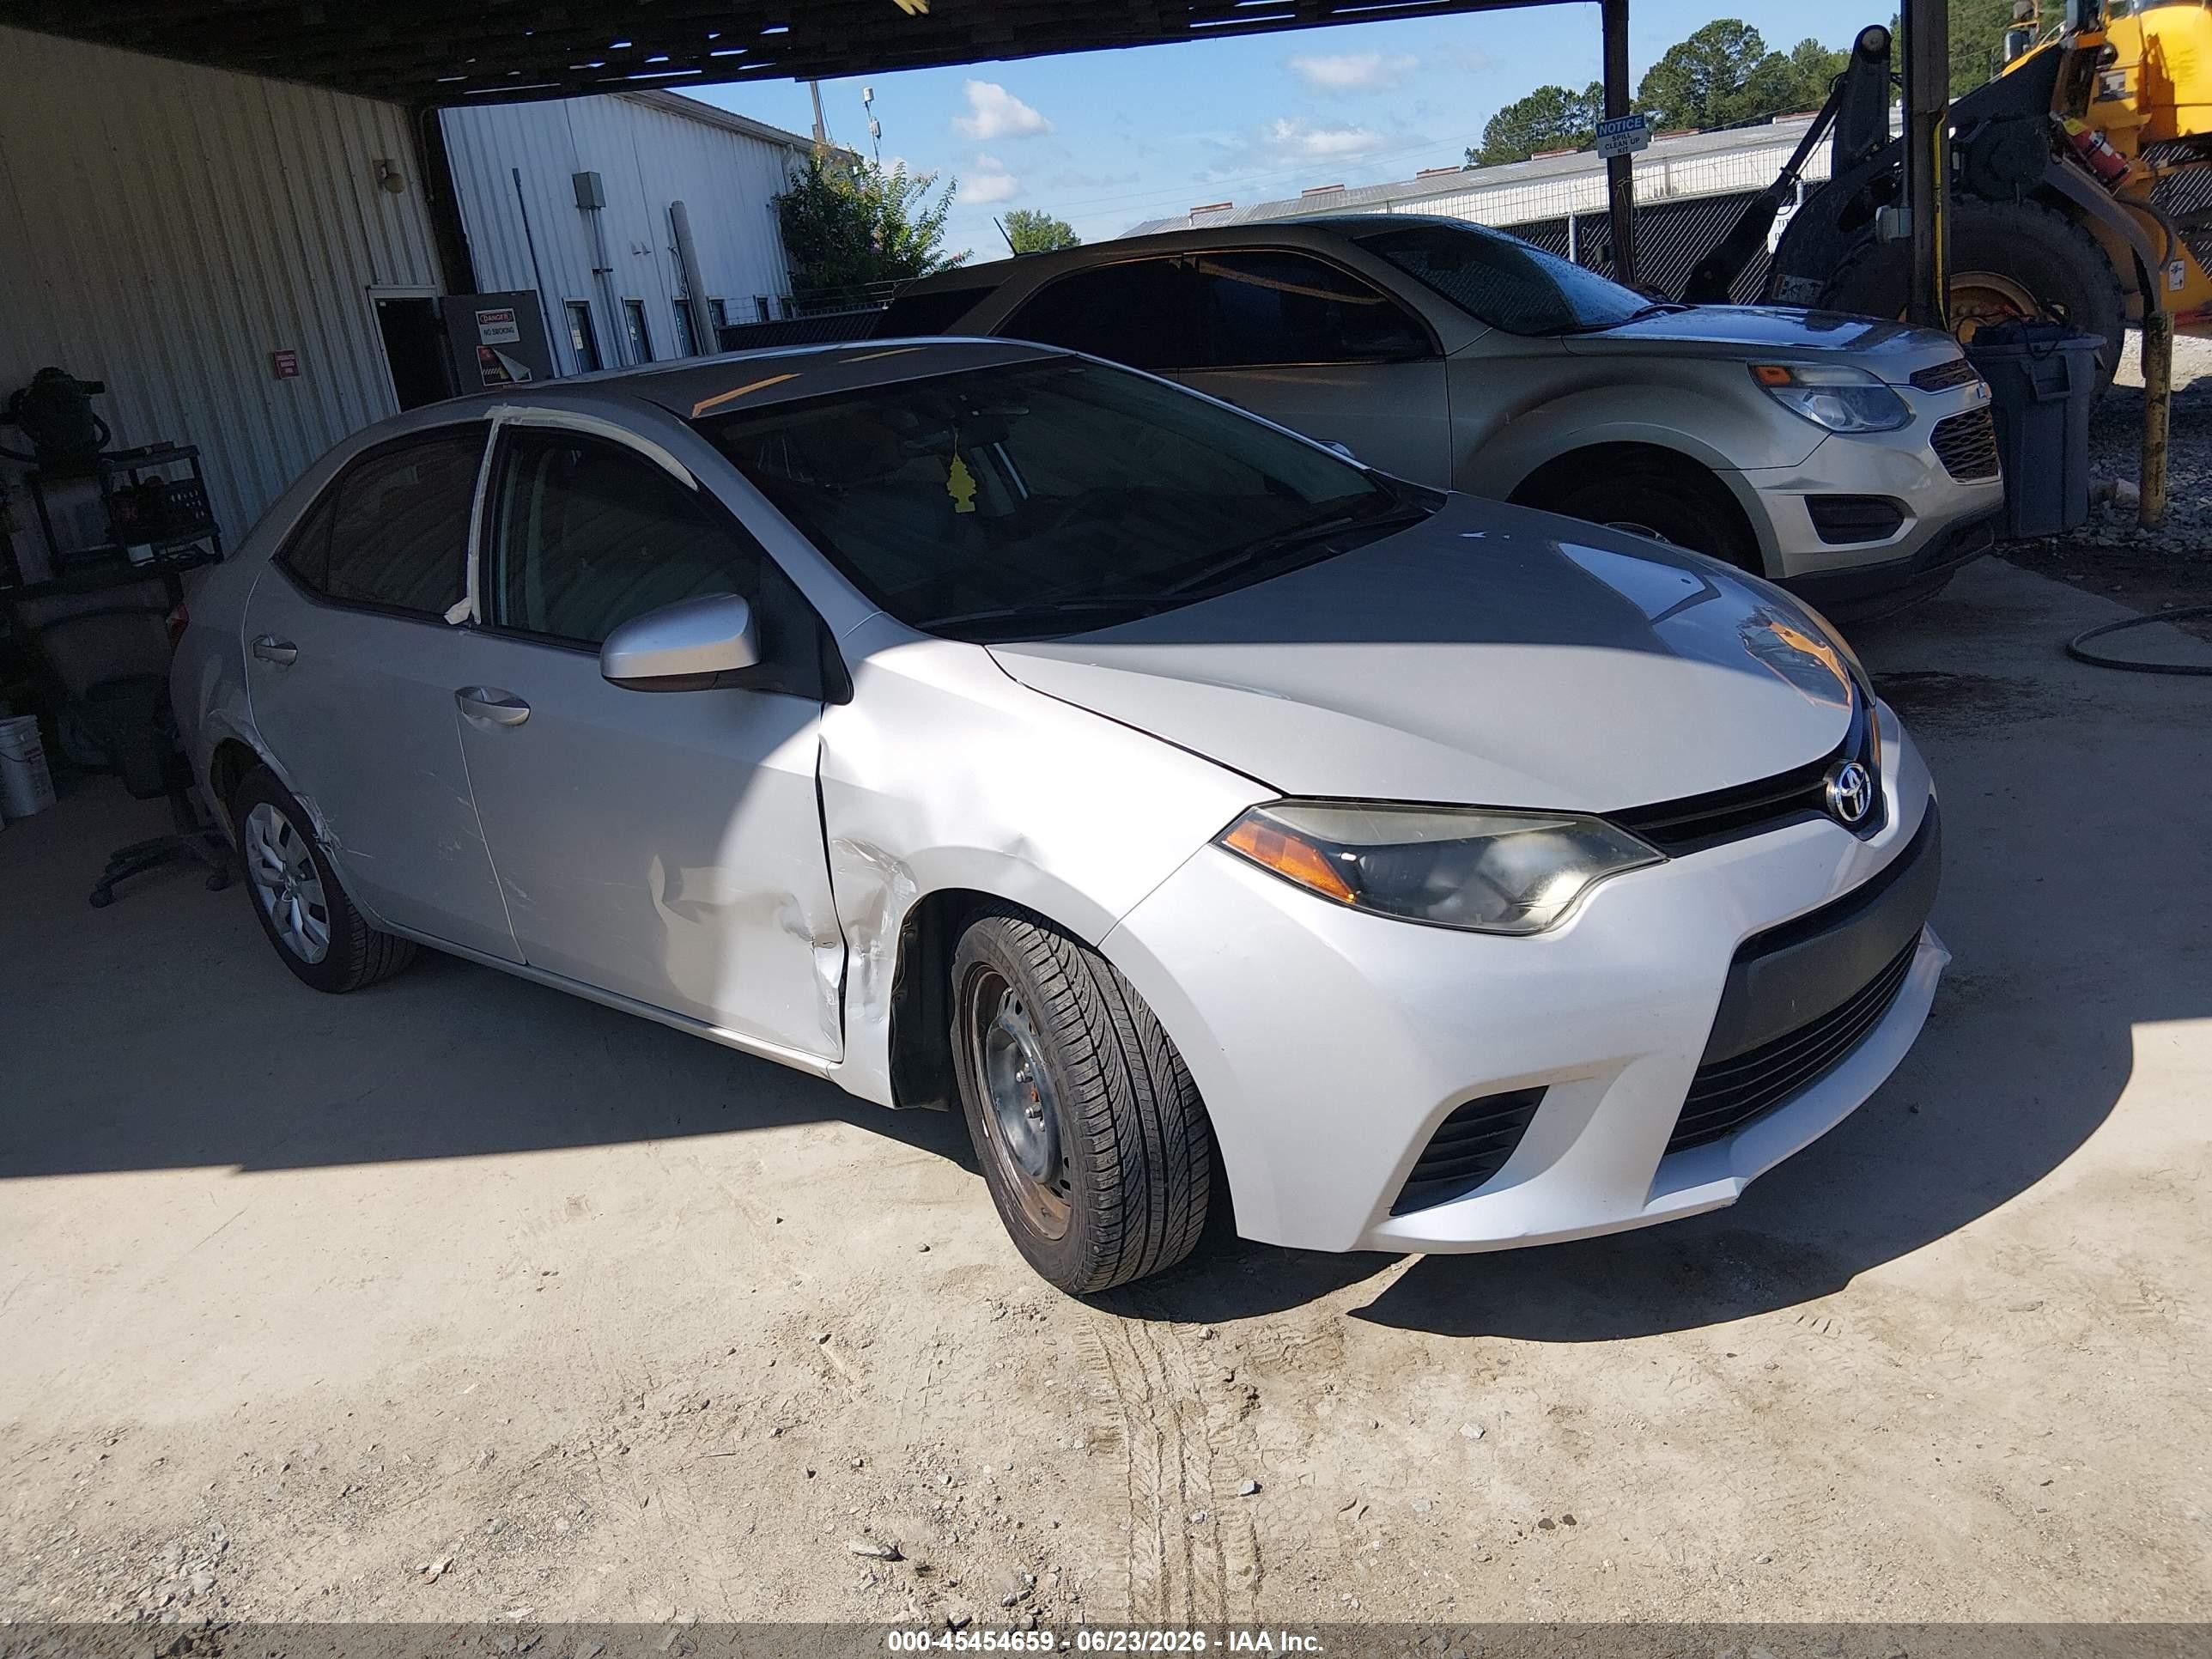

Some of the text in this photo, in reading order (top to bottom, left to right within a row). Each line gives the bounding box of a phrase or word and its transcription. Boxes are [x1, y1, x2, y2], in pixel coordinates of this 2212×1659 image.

[1599, 117, 1643, 136] NOTICE
[1612, 132, 1632, 142] SPILL
[1605, 140, 1628, 150] CLEAN
[483, 313, 509, 323] DANGER
[492, 326, 515, 336] SMOKING
